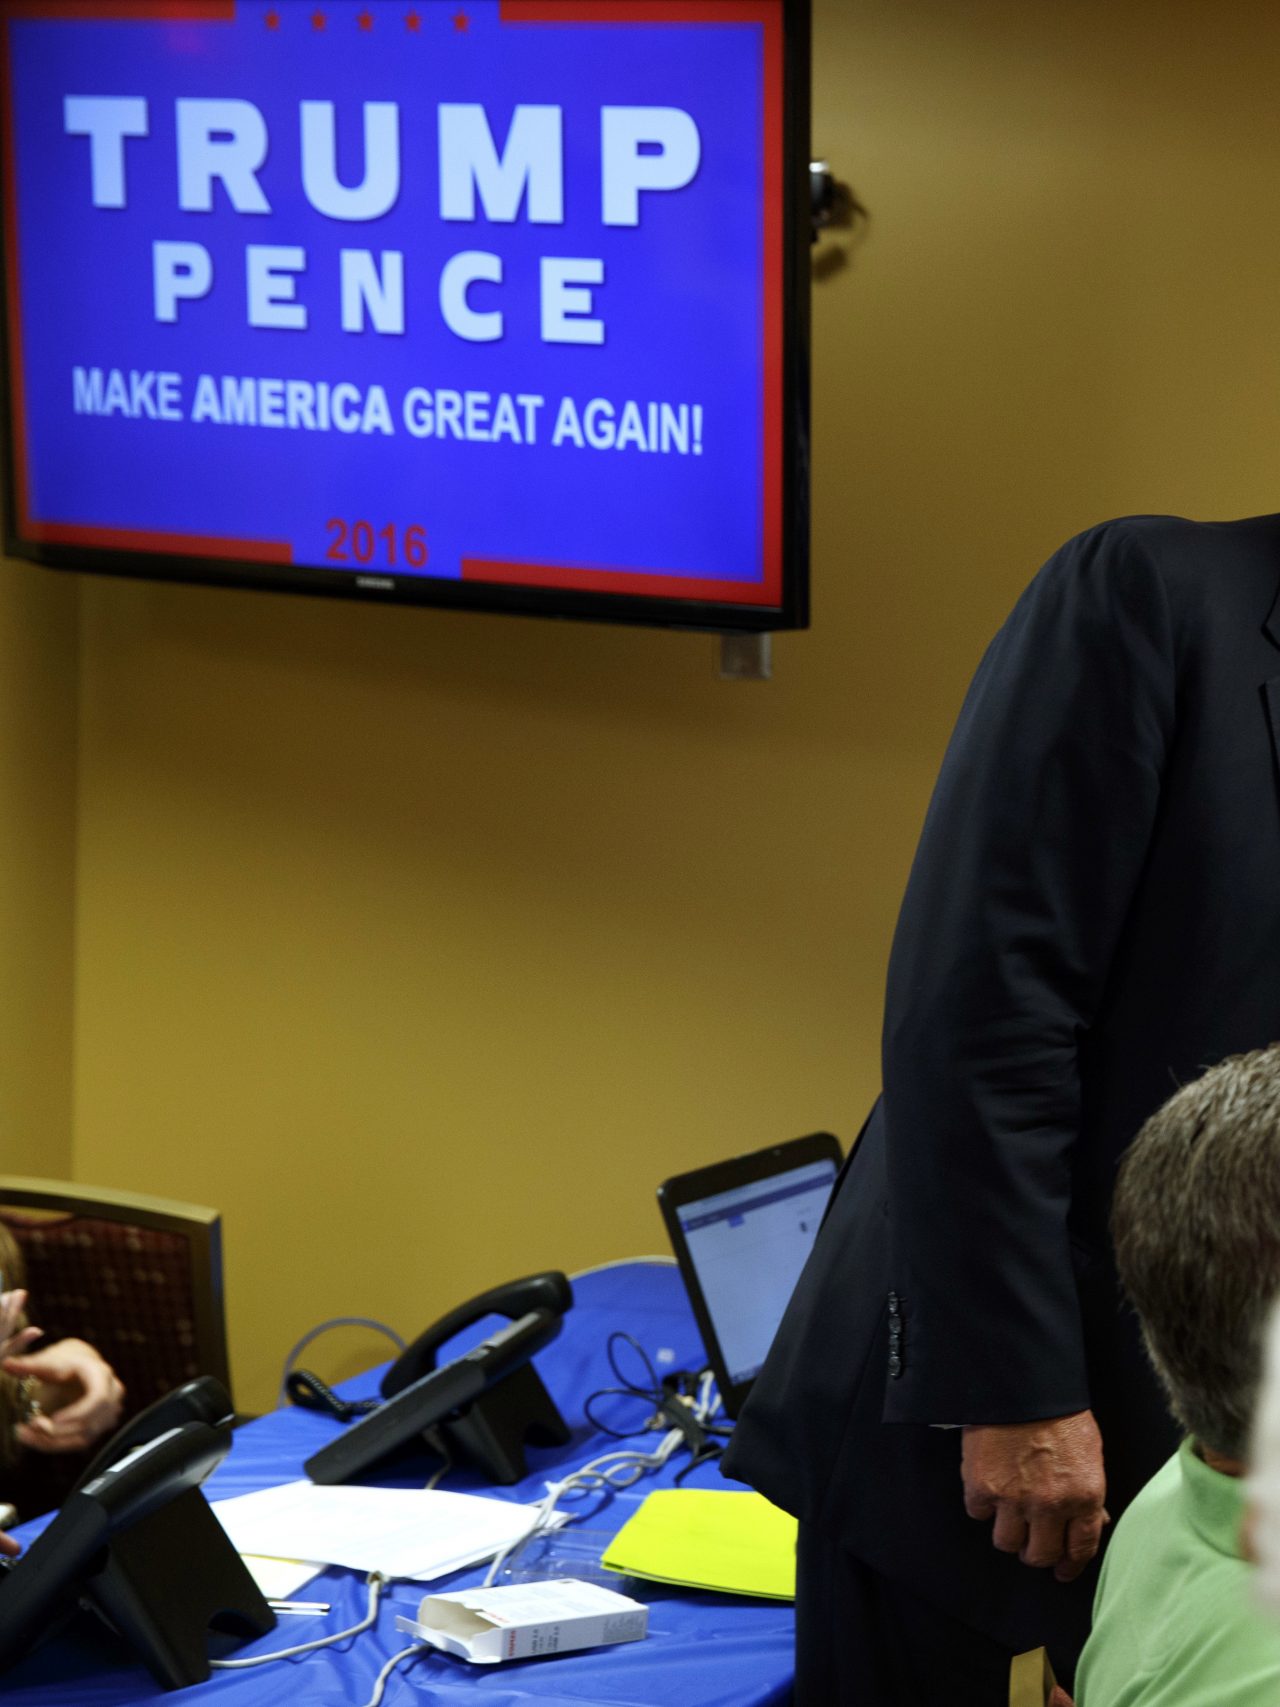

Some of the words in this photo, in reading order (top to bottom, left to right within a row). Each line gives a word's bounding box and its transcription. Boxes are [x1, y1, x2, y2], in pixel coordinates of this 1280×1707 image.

[64, 95, 701, 226] TRUMP
[152, 240, 605, 345] PENCE
[73, 367, 182, 421] MAKE
[192, 375, 394, 436] AMERICA
[404, 387, 544, 444] GREAT
[552, 397, 704, 456] AGAIN!
[325, 518, 429, 568] 2016
